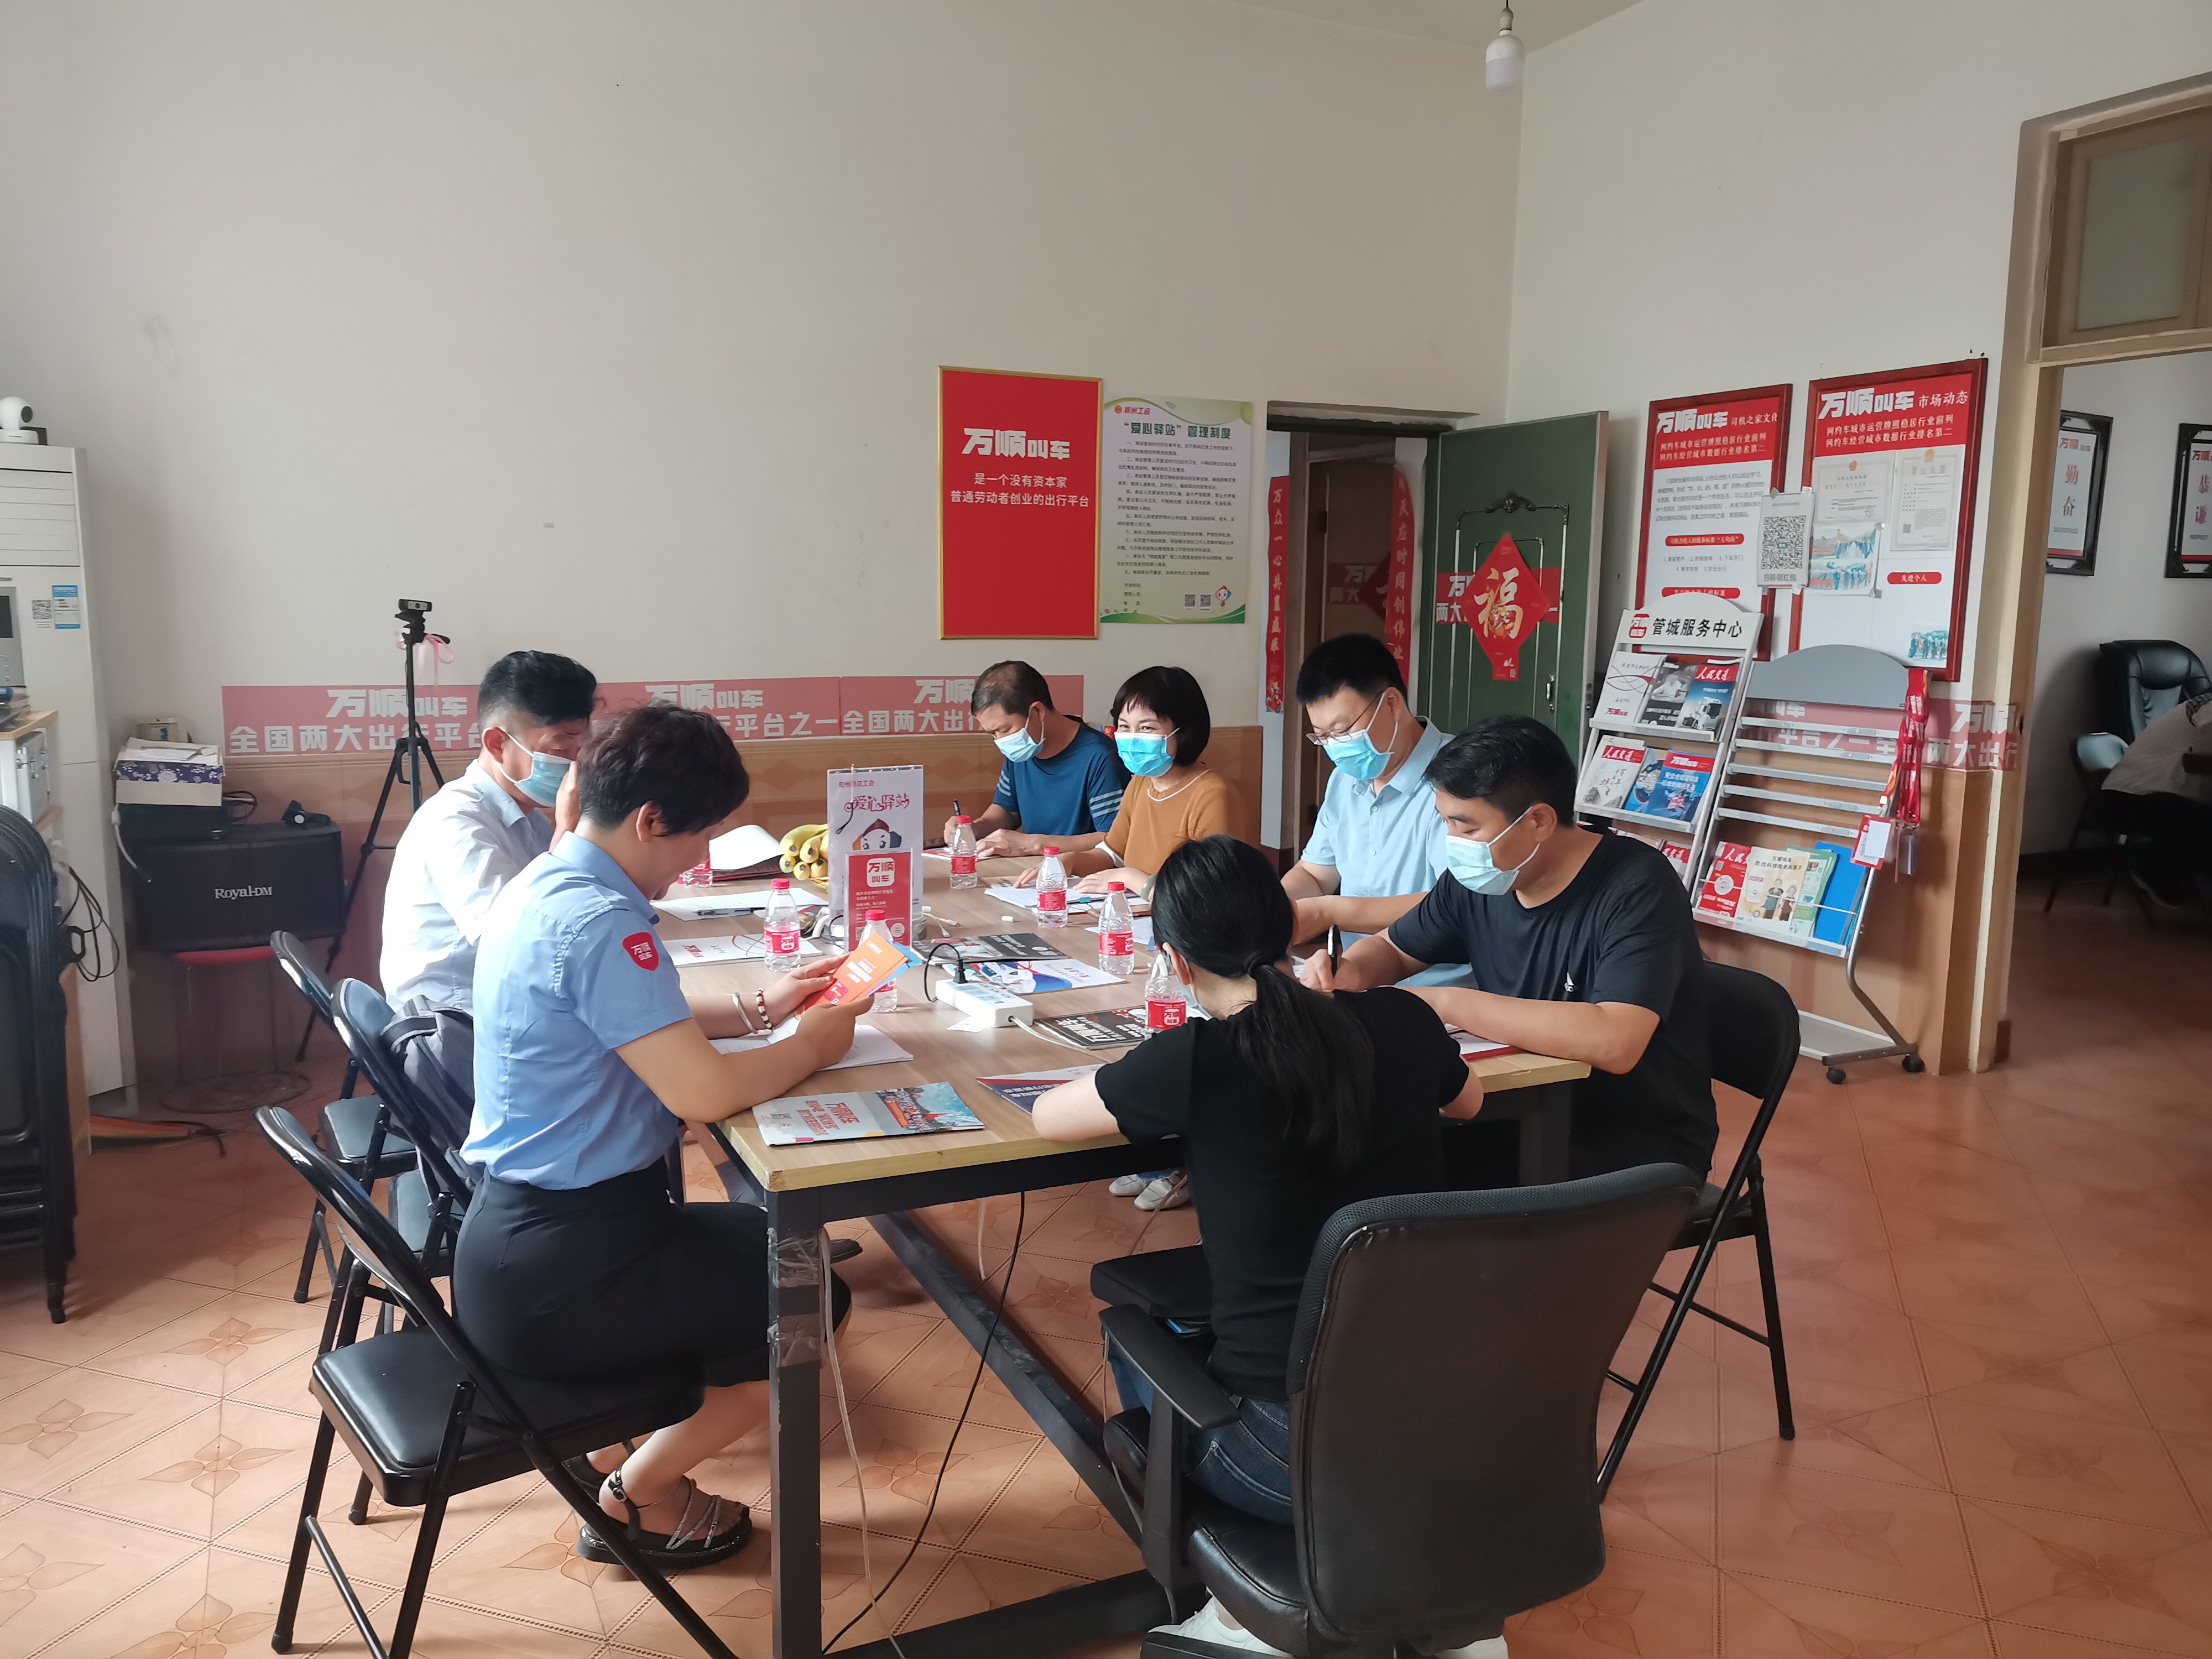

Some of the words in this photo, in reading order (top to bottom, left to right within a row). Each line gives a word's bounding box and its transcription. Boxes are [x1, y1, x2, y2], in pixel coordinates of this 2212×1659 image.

[1818, 388, 1915, 419] 万顺叫车
[1918, 390, 1968, 408] 市场动态
[1657, 409, 1729, 434] 万顺叫车
[962, 428, 1070, 460] 万顺叫车
[974, 473, 1067, 488] 是一个没有资本家
[951, 490, 1089, 507] 普通劳动者创业的出行平台
[1436, 603, 1468, 622] 两大
[1474, 567, 1523, 639] 福
[1652, 618, 1742, 638] 管城服务中心
[325, 689, 467, 718] 万顺叫车
[844, 793, 910, 812] 爱心驿站
[868, 862, 894, 873] 万顺
[215, 885, 272, 900] Royal-DM
